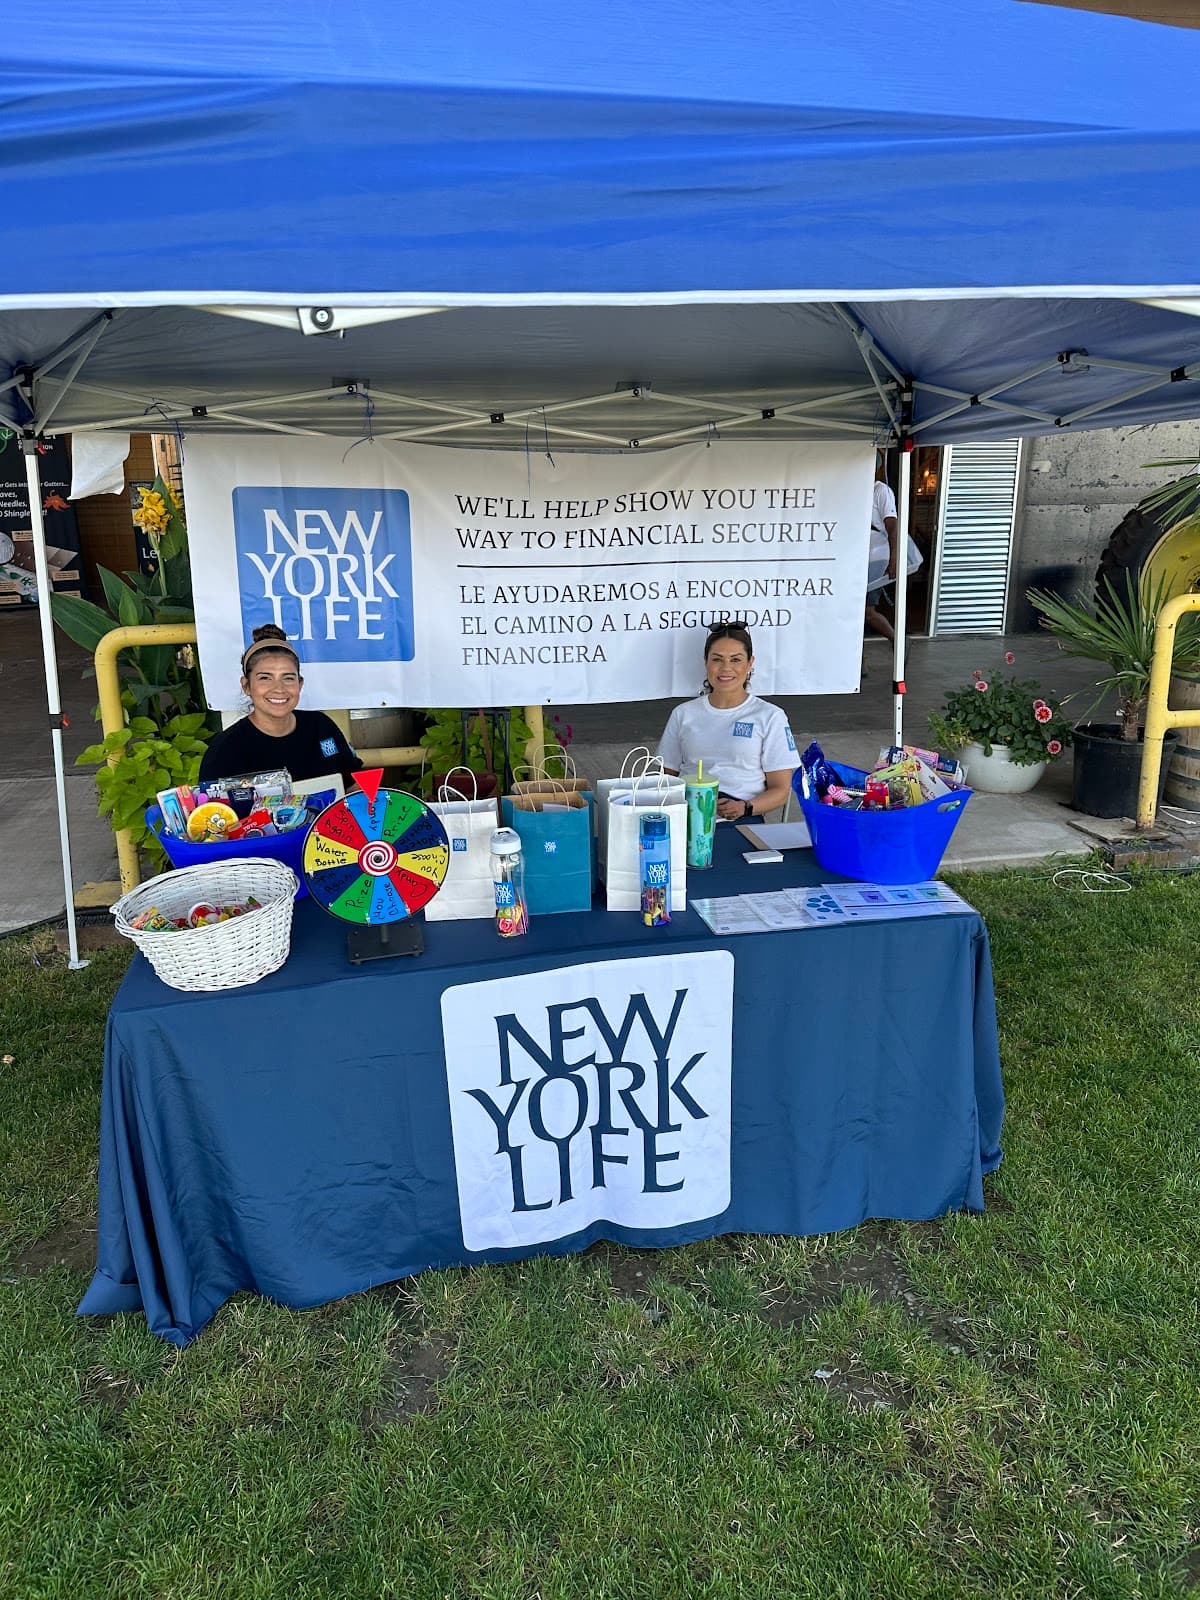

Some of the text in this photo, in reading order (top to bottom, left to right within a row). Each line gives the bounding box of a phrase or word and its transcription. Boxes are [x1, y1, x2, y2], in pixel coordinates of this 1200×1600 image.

[454, 488, 816, 519] WE'LL HELP SHOW YOU THE
[263, 509, 383, 555] NEW
[455, 521, 838, 549] WAY TO FINANCIAL SECURITY
[244, 552, 399, 599] YORK
[459, 577, 834, 604] LE AYUDAREMOS A ENCONTRAR
[272, 596, 385, 640] LIFE
[460, 608, 792, 635] EL CAMINO A LA SEGURIDAD
[462, 644, 608, 666] FINANCIERA
[314, 857, 347, 867] Bottle
[316, 841, 348, 857] Water
[420, 865, 438, 879] You
[648, 869, 668, 878] YORK
[649, 863, 667, 872] NEW
[650, 876, 667, 884] LIFE
[493, 988, 689, 1088] NEW
[460, 1051, 710, 1155] YORK
[504, 1122, 686, 1213] LIFE
